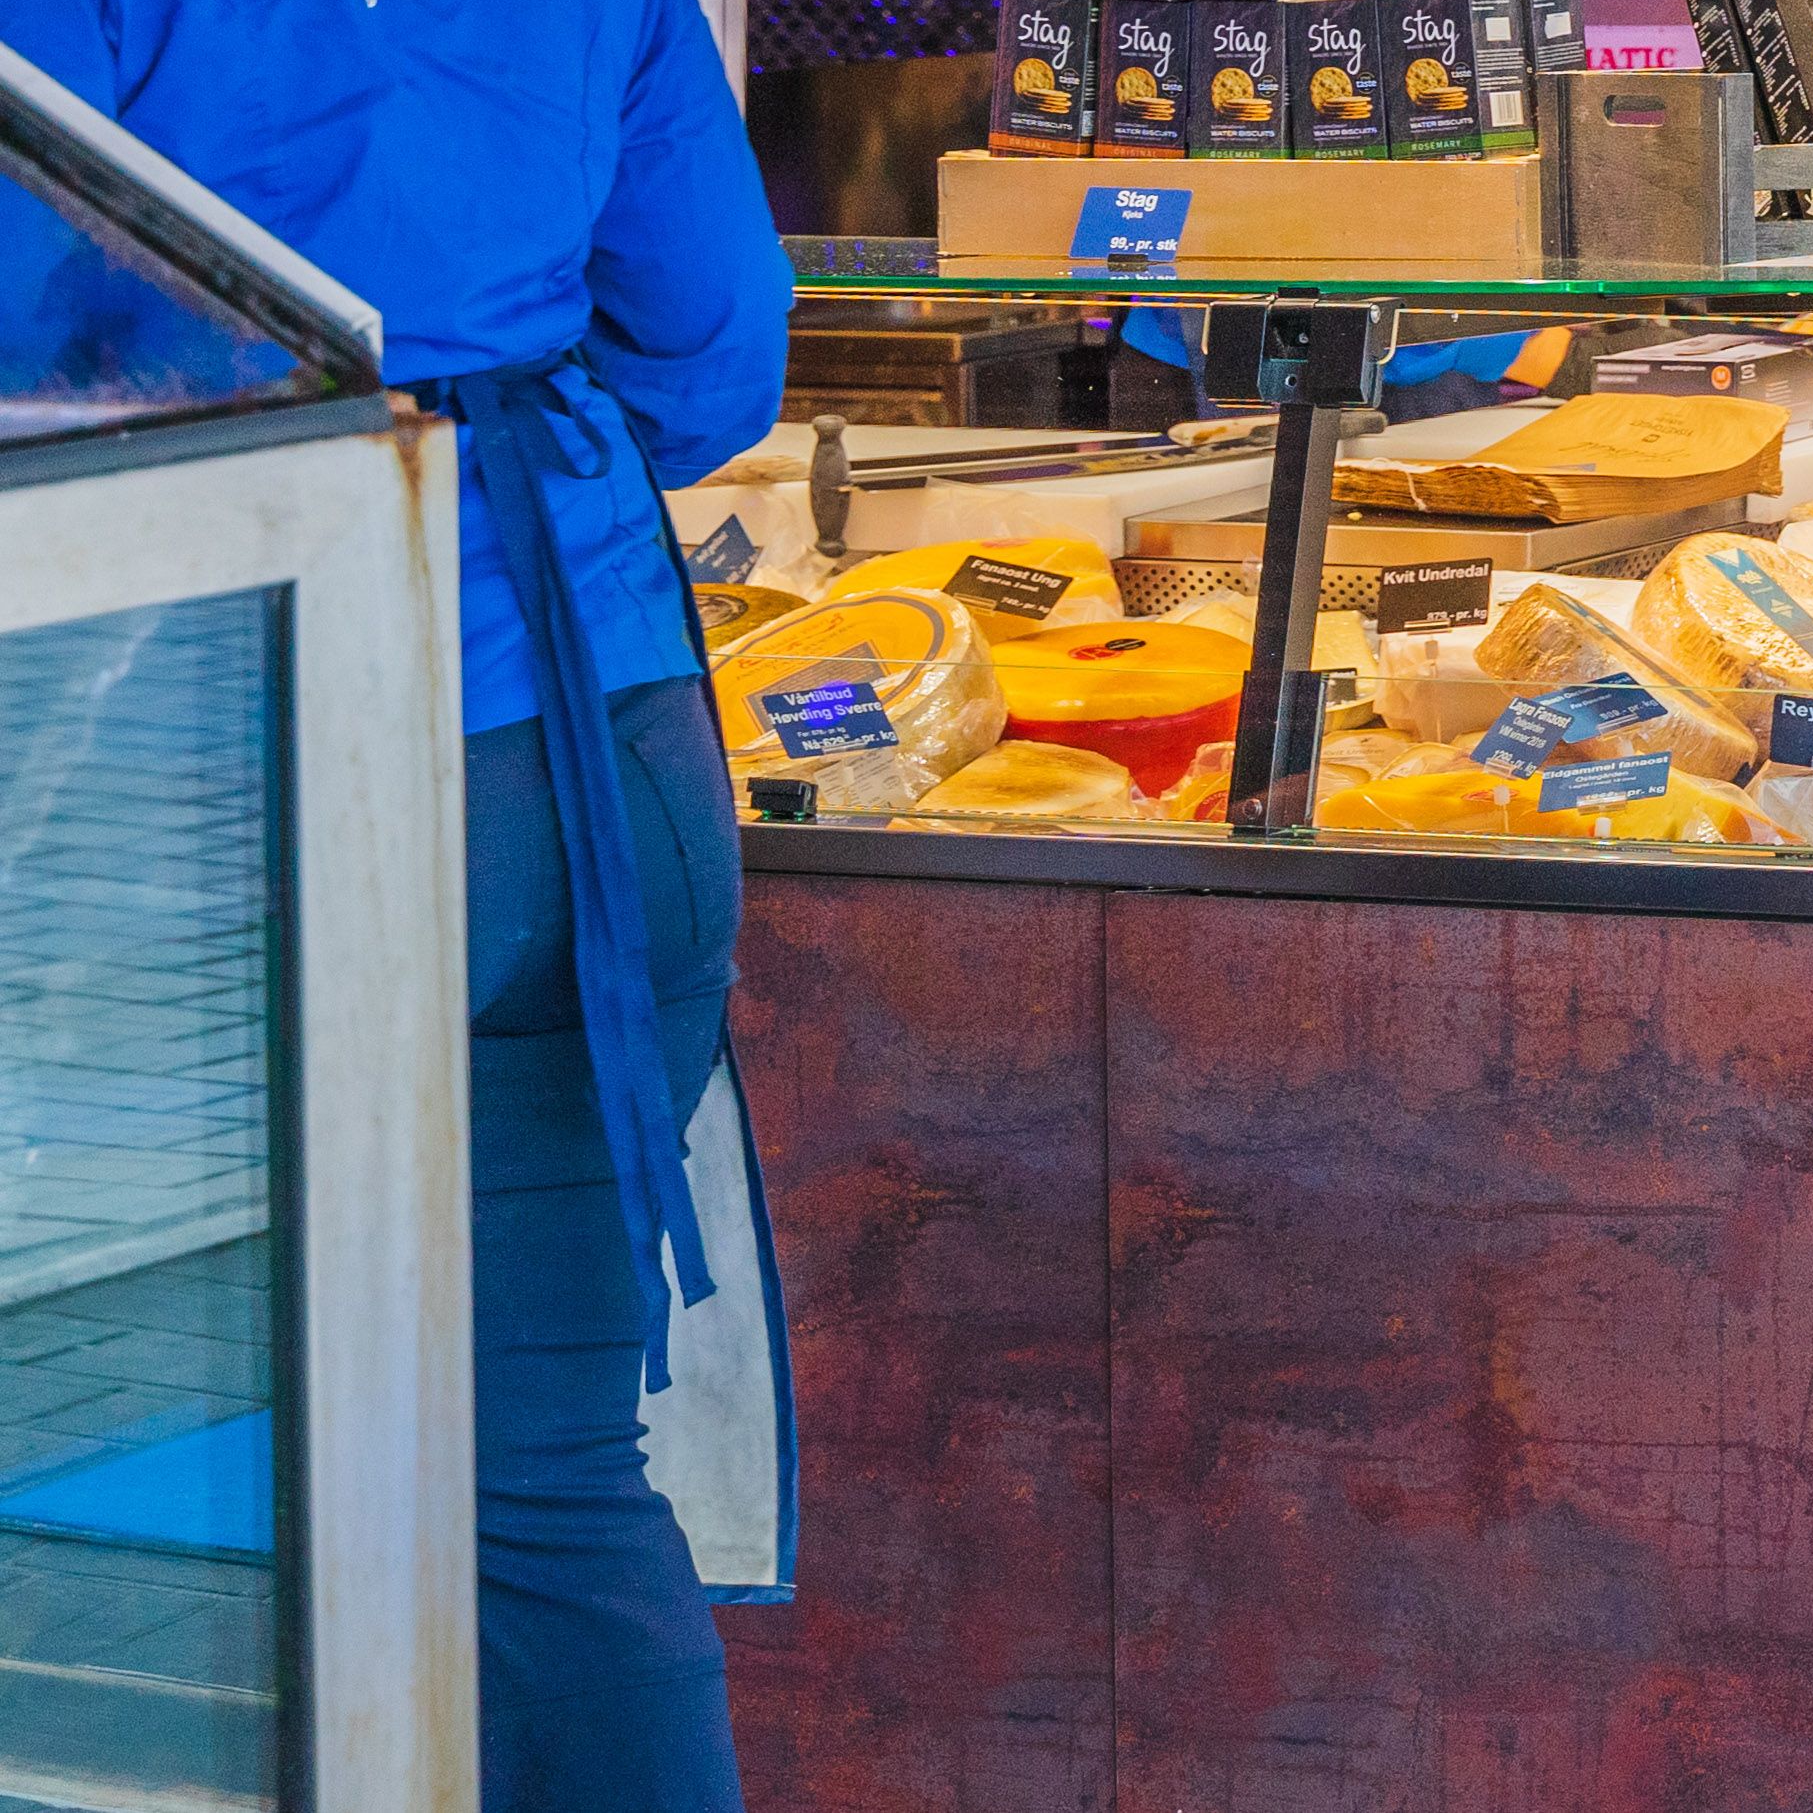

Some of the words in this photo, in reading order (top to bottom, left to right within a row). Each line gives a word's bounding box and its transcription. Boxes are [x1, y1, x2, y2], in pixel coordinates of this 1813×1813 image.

[1017, 10, 1075, 70] Stag
[1308, 18, 1366, 75] Stag
[1402, 10, 1460, 66] Stag
[1118, 18, 1175, 78] Stag
[1214, 19, 1272, 77] Stag
[1409, 119, 1436, 130] WATER
[1436, 117, 1474, 128] BISCUITS
[1315, 148, 1365, 159] ROSEMARY
[1411, 139, 1462, 152] ROSEMARY
[1115, 190, 1158, 212] Stag
[1110, 237, 1134, 251] 99,-
[1135, 239, 1154, 252] pr.
[1156, 238, 1178, 251] stk
[970, 559, 1031, 580] Fanaost
[1030, 573, 1062, 589] Ung
[1383, 571, 1416, 585] Kvit
[1418, 563, 1490, 582] Undredal
[1456, 610, 1472, 622] pr.
[1473, 608, 1489, 620] kg
[783, 687, 853, 706] Vårtilbud
[1645, 698, 1659, 709] kg
[768, 708, 834, 725] Høvding
[834, 701, 884, 717] Sverre
[1509, 697, 1535, 718] Lagra
[1534, 706, 1574, 729] Fanaost
[880, 729, 897, 742] kg
[1524, 762, 1538, 777] kg
[1618, 755, 1670, 769] fanaost
[1626, 789, 1645, 798] pr.
[1648, 785, 1666, 796] kg
